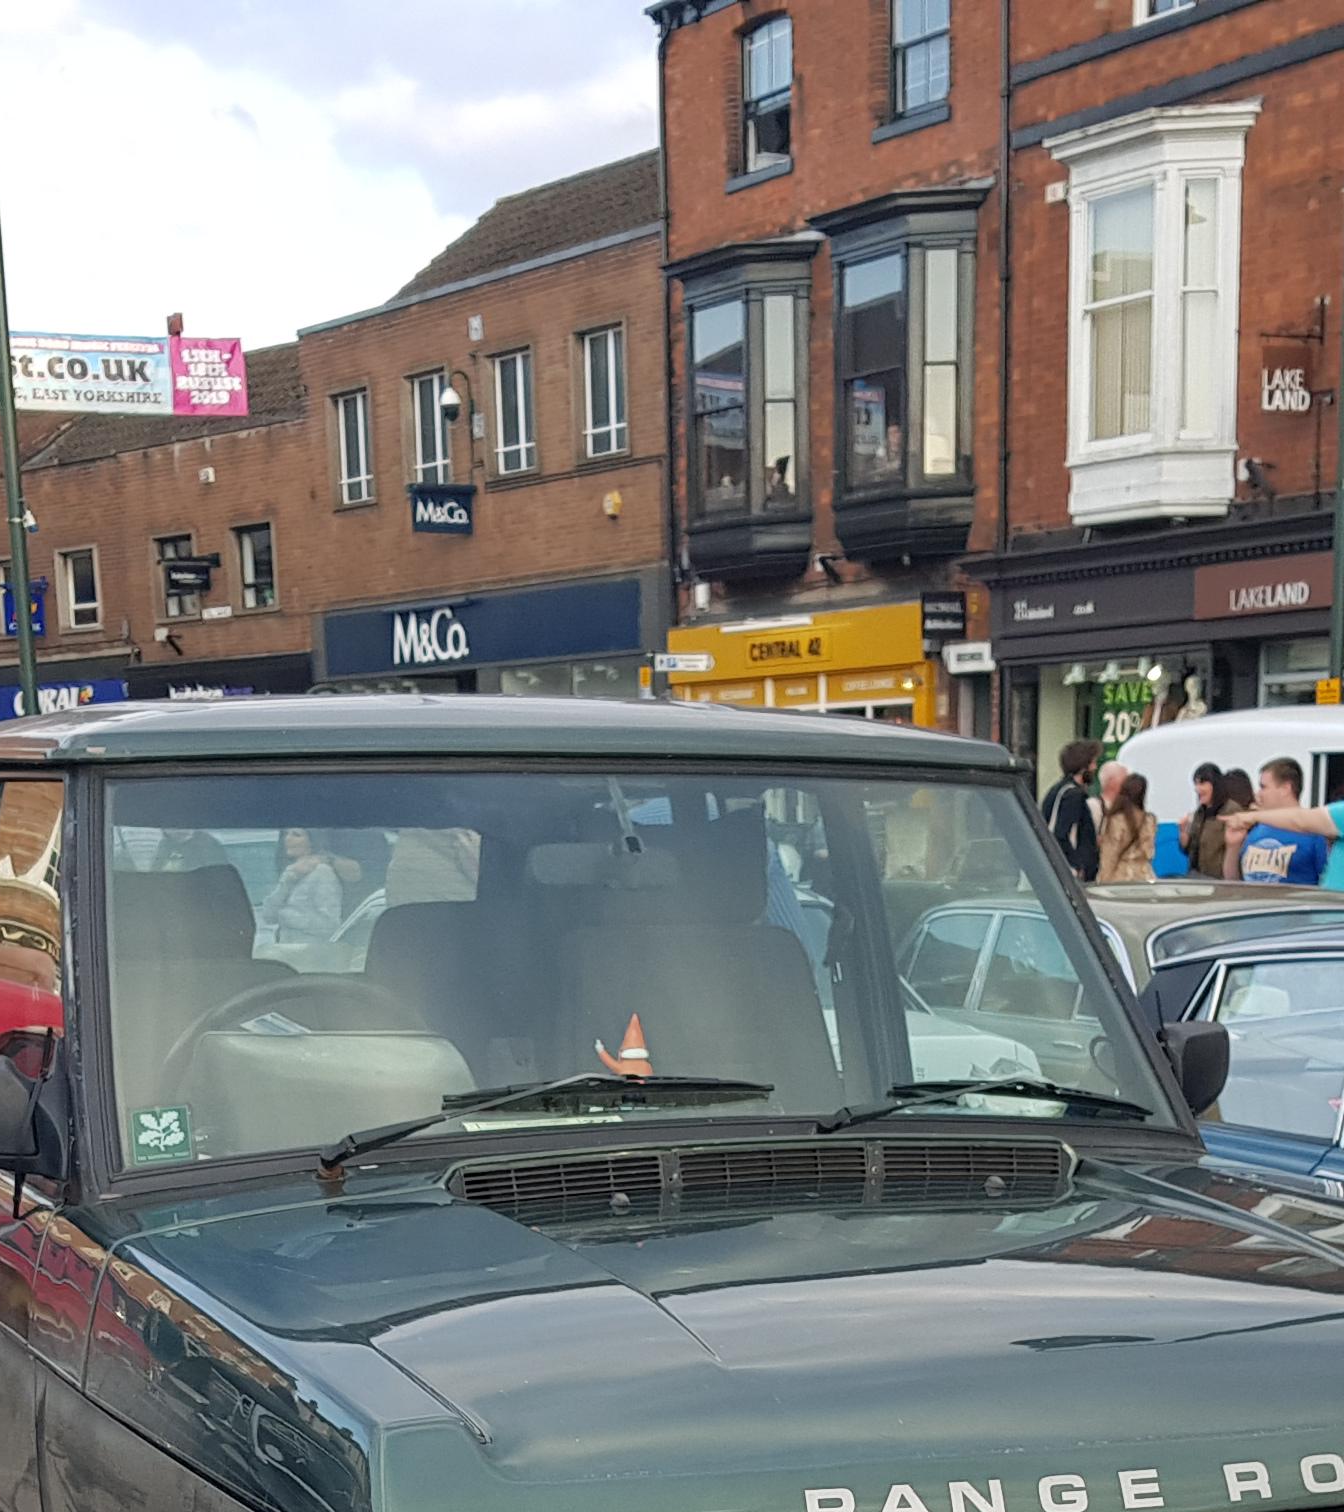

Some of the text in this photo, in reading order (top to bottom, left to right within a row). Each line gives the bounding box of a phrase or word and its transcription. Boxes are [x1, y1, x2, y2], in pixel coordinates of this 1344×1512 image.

[1262, 368, 1304, 390] LAKE
[33, 387, 70, 401] EAST
[73, 389, 162, 404] YORKSHIRE
[1261, 389, 1311, 411] LAND
[1230, 581, 1310, 611] LAKELAND
[393, 607, 469, 665] M&Co.
[750, 641, 802, 661] CENTRAL
[14, 687, 79, 716] CRAL
[1104, 681, 1152, 704] SAVE
